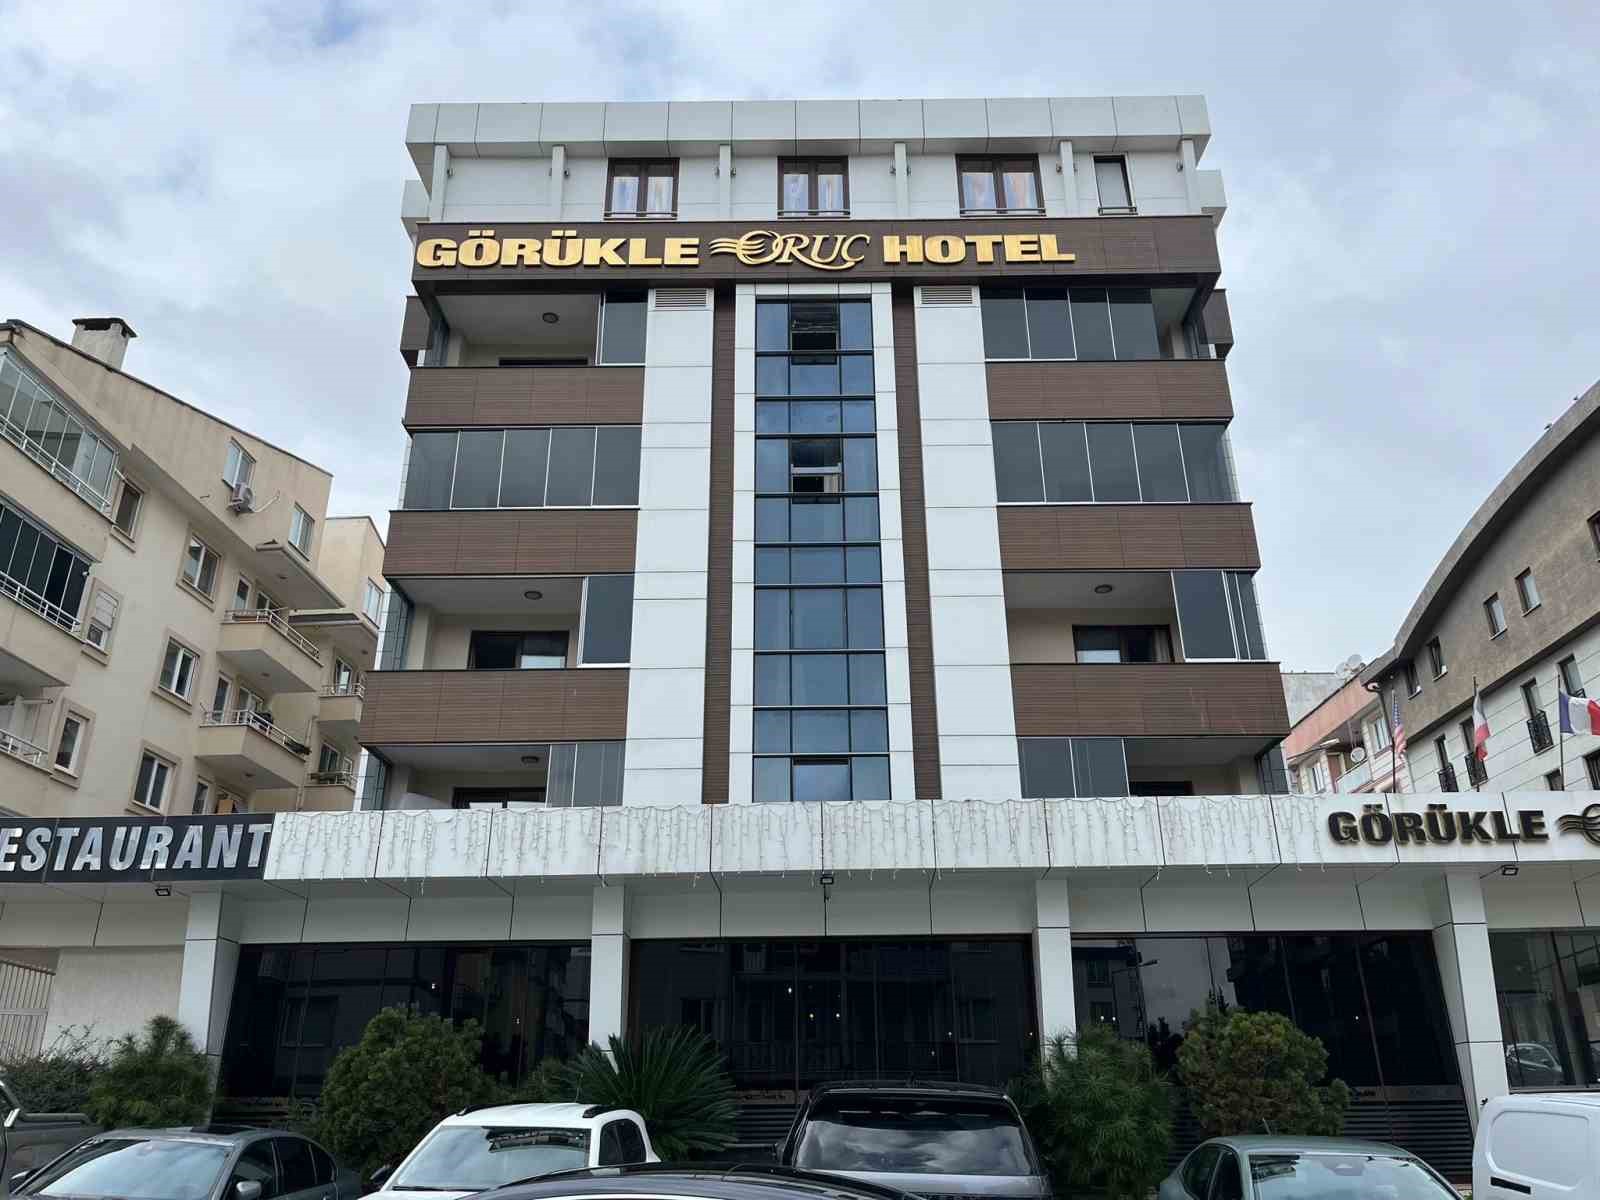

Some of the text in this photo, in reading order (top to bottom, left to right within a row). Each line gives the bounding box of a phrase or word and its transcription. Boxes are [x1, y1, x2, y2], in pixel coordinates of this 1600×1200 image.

[416, 230, 700, 267] GÖRÜKLE
[883, 234, 1075, 264] HOTEL
[1328, 803, 1549, 845] GÖRÜKLE
